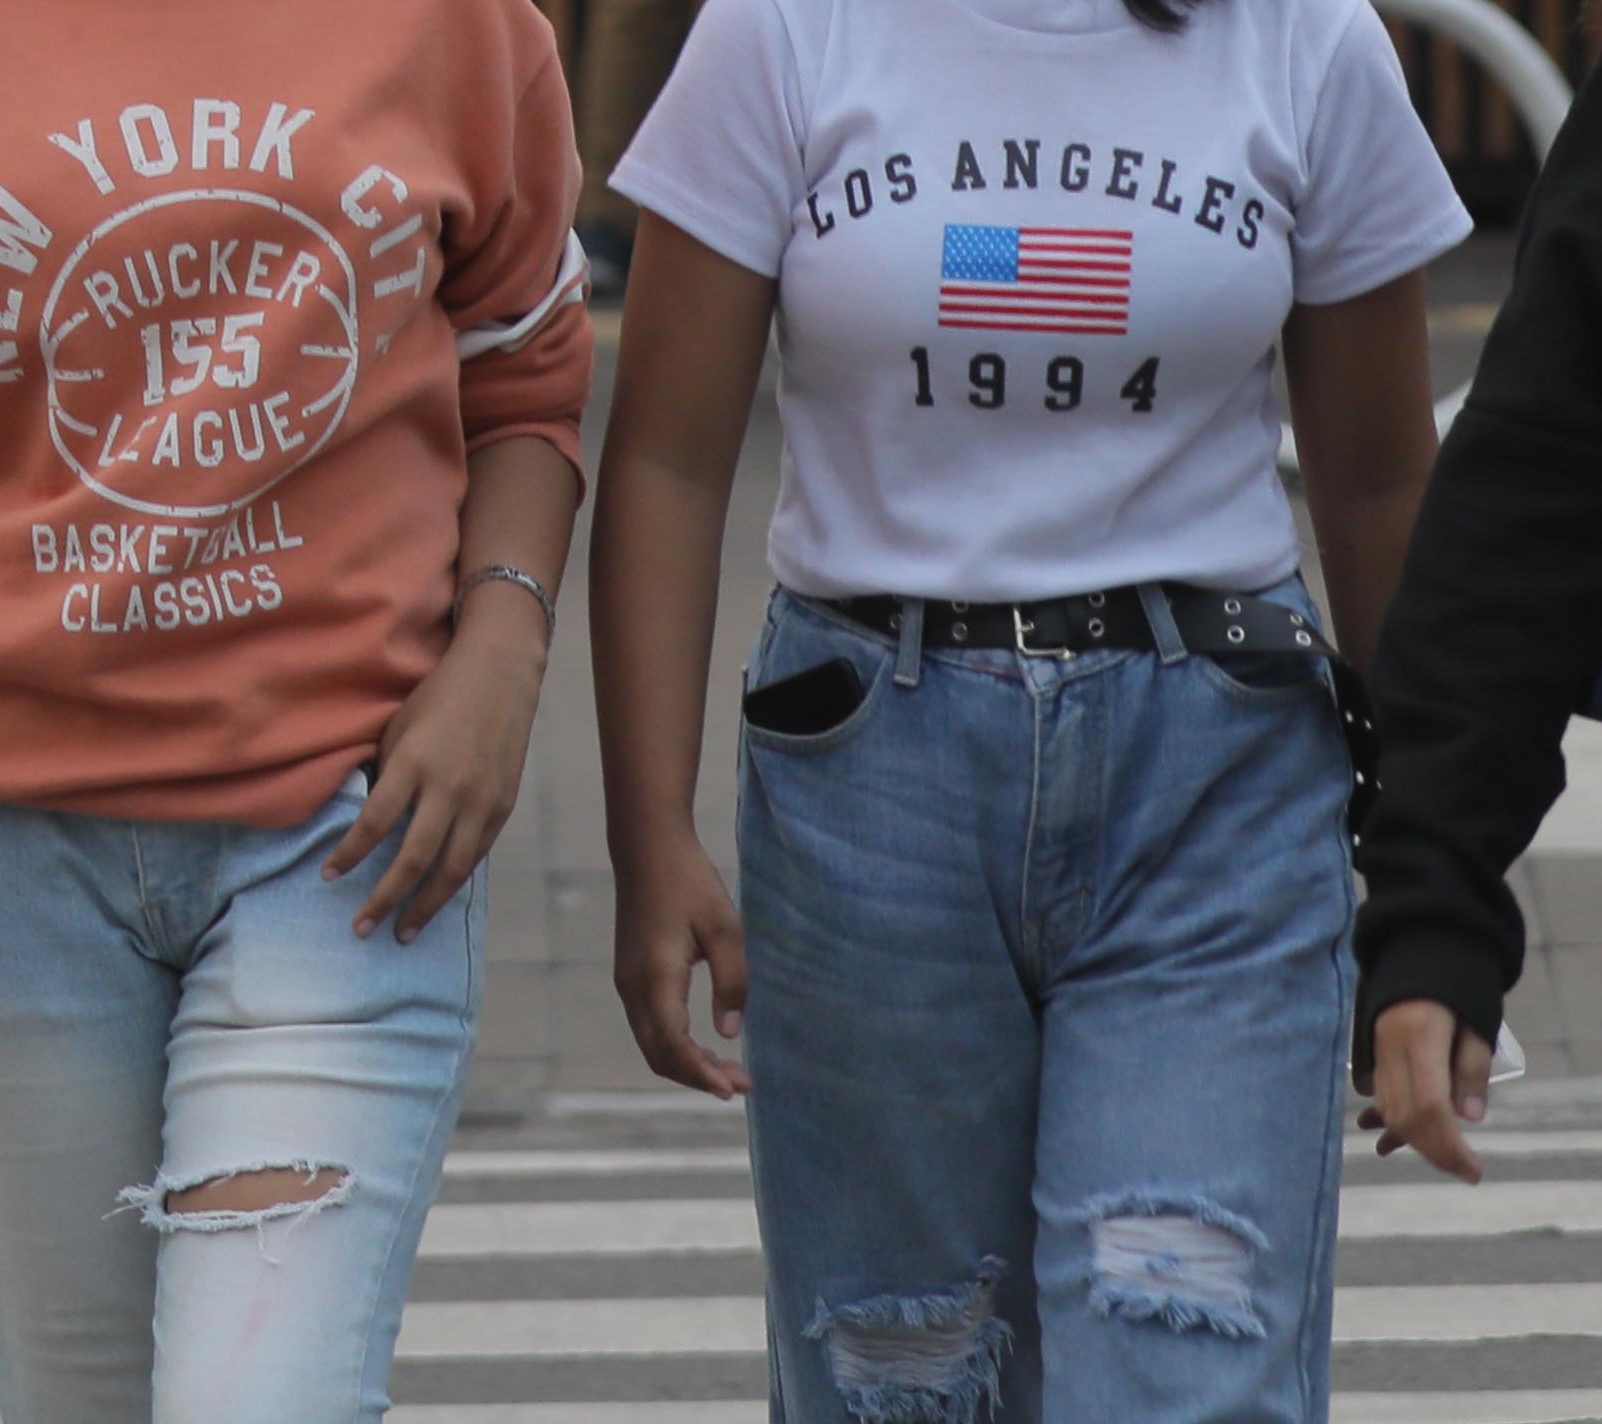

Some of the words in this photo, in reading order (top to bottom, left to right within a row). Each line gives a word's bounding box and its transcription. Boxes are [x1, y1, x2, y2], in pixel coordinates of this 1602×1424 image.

[46, 96, 317, 195] YORK
[340, 160, 428, 356] CIT
[806, 154, 916, 240] LOS
[951, 140, 1266, 250] ANGELES
[83, 238, 324, 330] RUCKER
[139, 310, 266, 407] 155
[908, 344, 1161, 414] 1994
[97, 390, 306, 470] LEAGUE
[61, 563, 283, 633] CLASSICS
